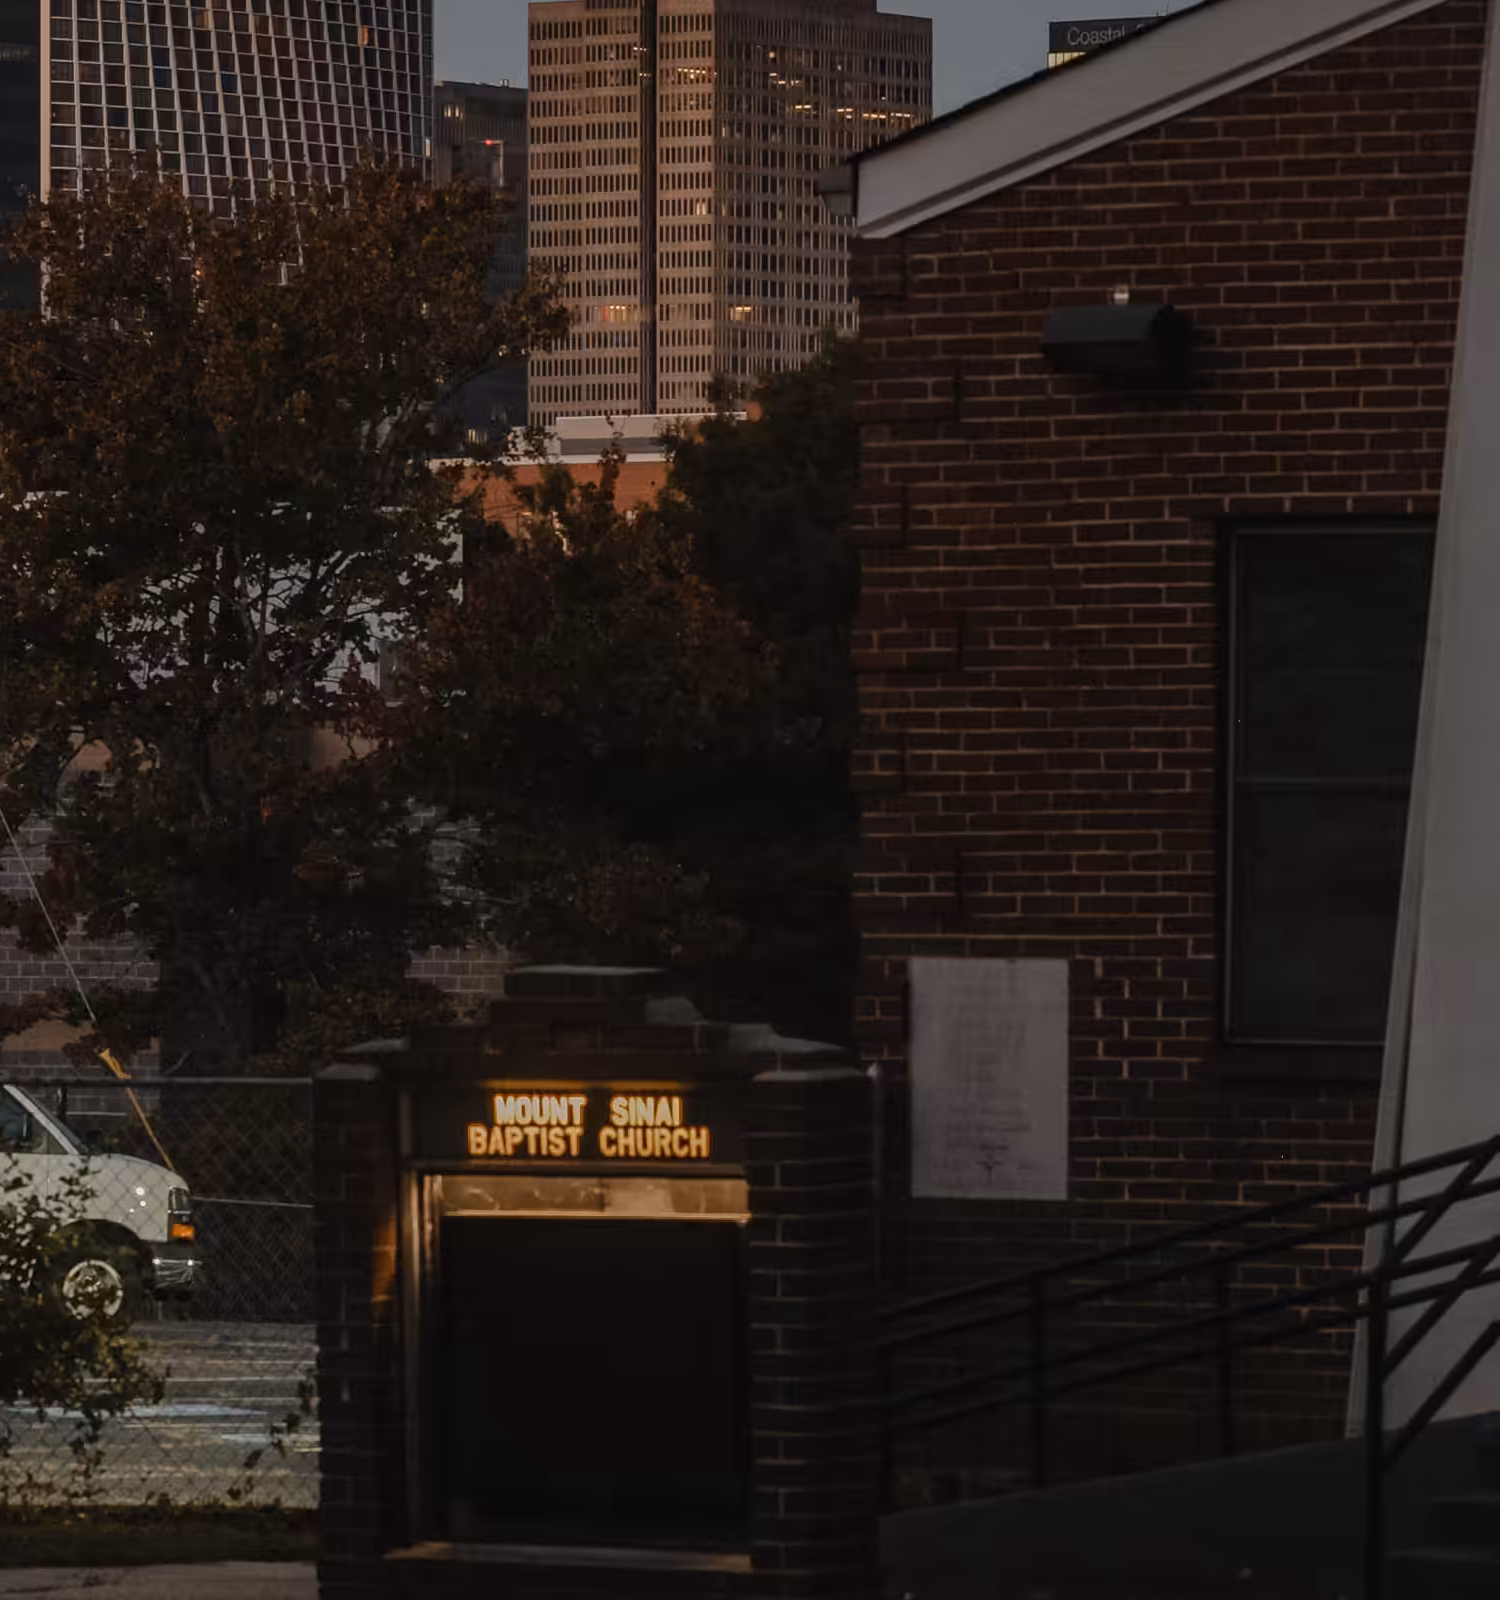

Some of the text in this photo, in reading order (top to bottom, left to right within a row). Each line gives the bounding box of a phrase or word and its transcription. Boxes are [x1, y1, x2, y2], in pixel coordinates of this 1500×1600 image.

[1067, 26, 1125, 46] Coastal
[494, 1094, 682, 1127] MOUNT SINAI
[468, 1123, 710, 1158] BAPTIST CHURCH
